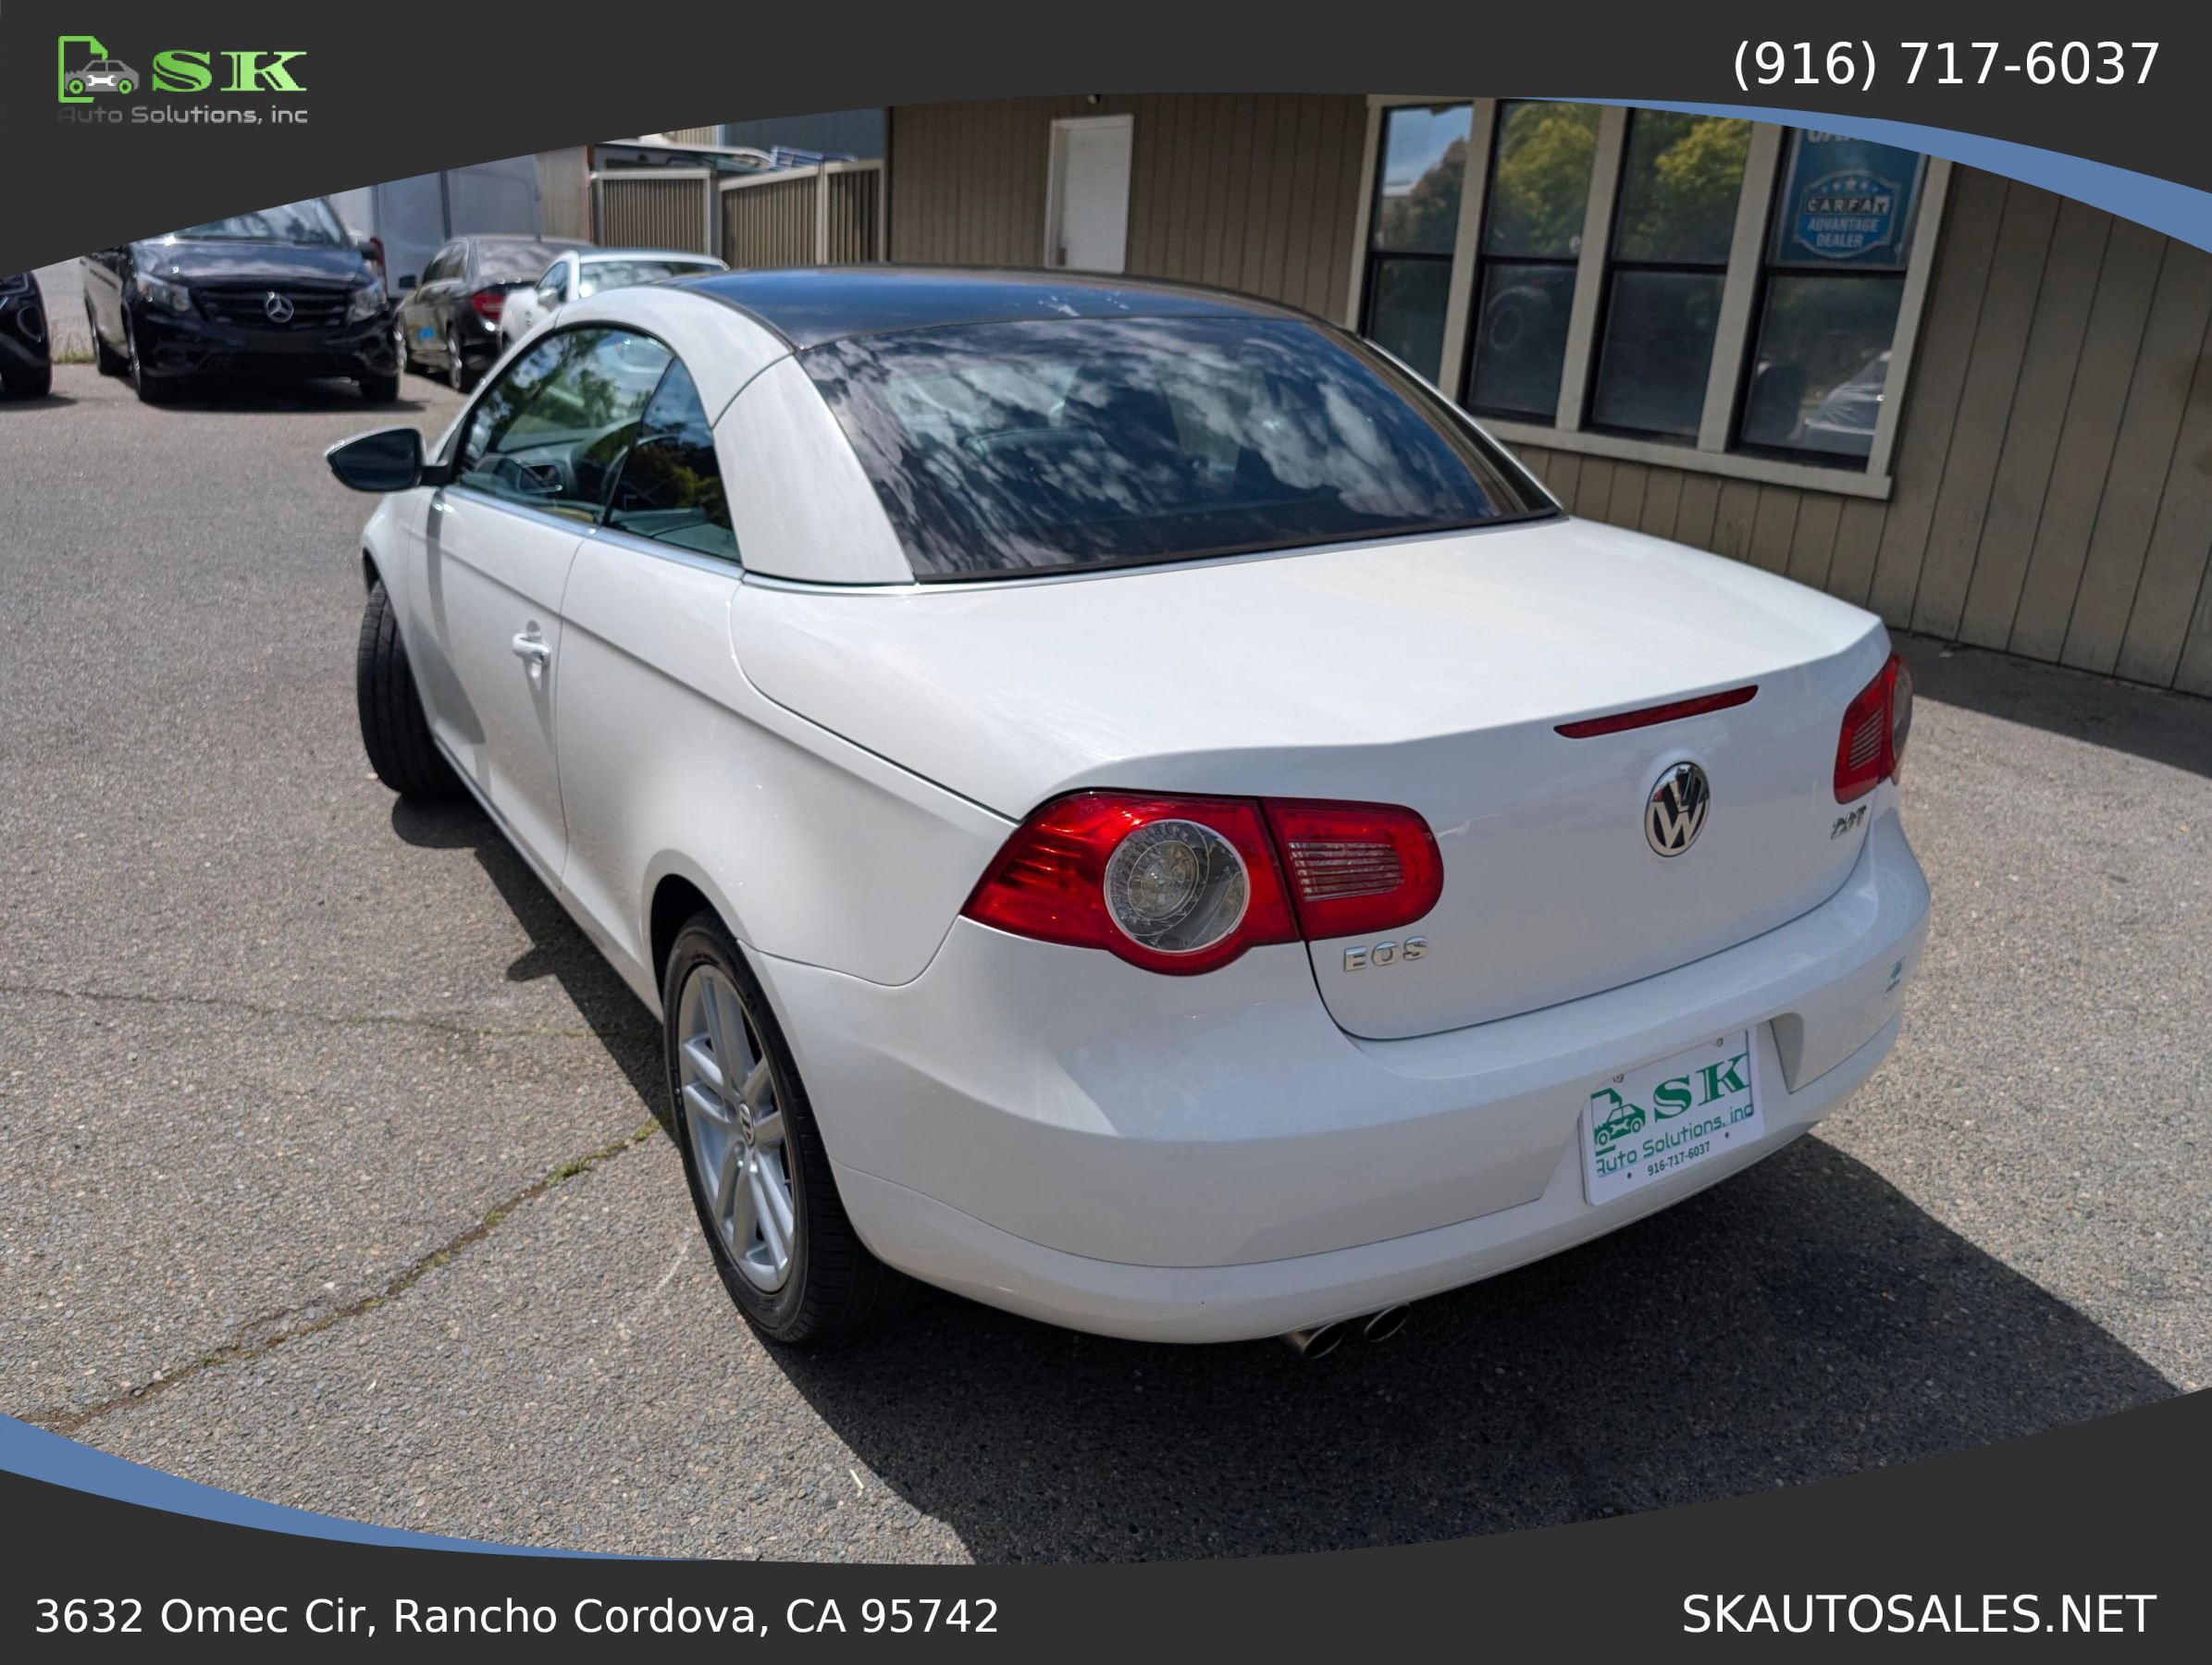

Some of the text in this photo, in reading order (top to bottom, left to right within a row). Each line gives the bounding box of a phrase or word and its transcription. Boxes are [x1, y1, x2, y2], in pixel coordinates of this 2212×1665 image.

[1807, 197, 1889, 214] CARFAX
[1807, 216, 1880, 232] ADVANTAGE
[1816, 233, 1864, 248] DEALER
[1343, 935, 1428, 972] EOS
[1653, 1052, 1750, 1123] SK
[1596, 1149, 1637, 1175] Auto
[1642, 1116, 1726, 1158] Solutions,
[1647, 1141, 1712, 1177] 916-717-6037
